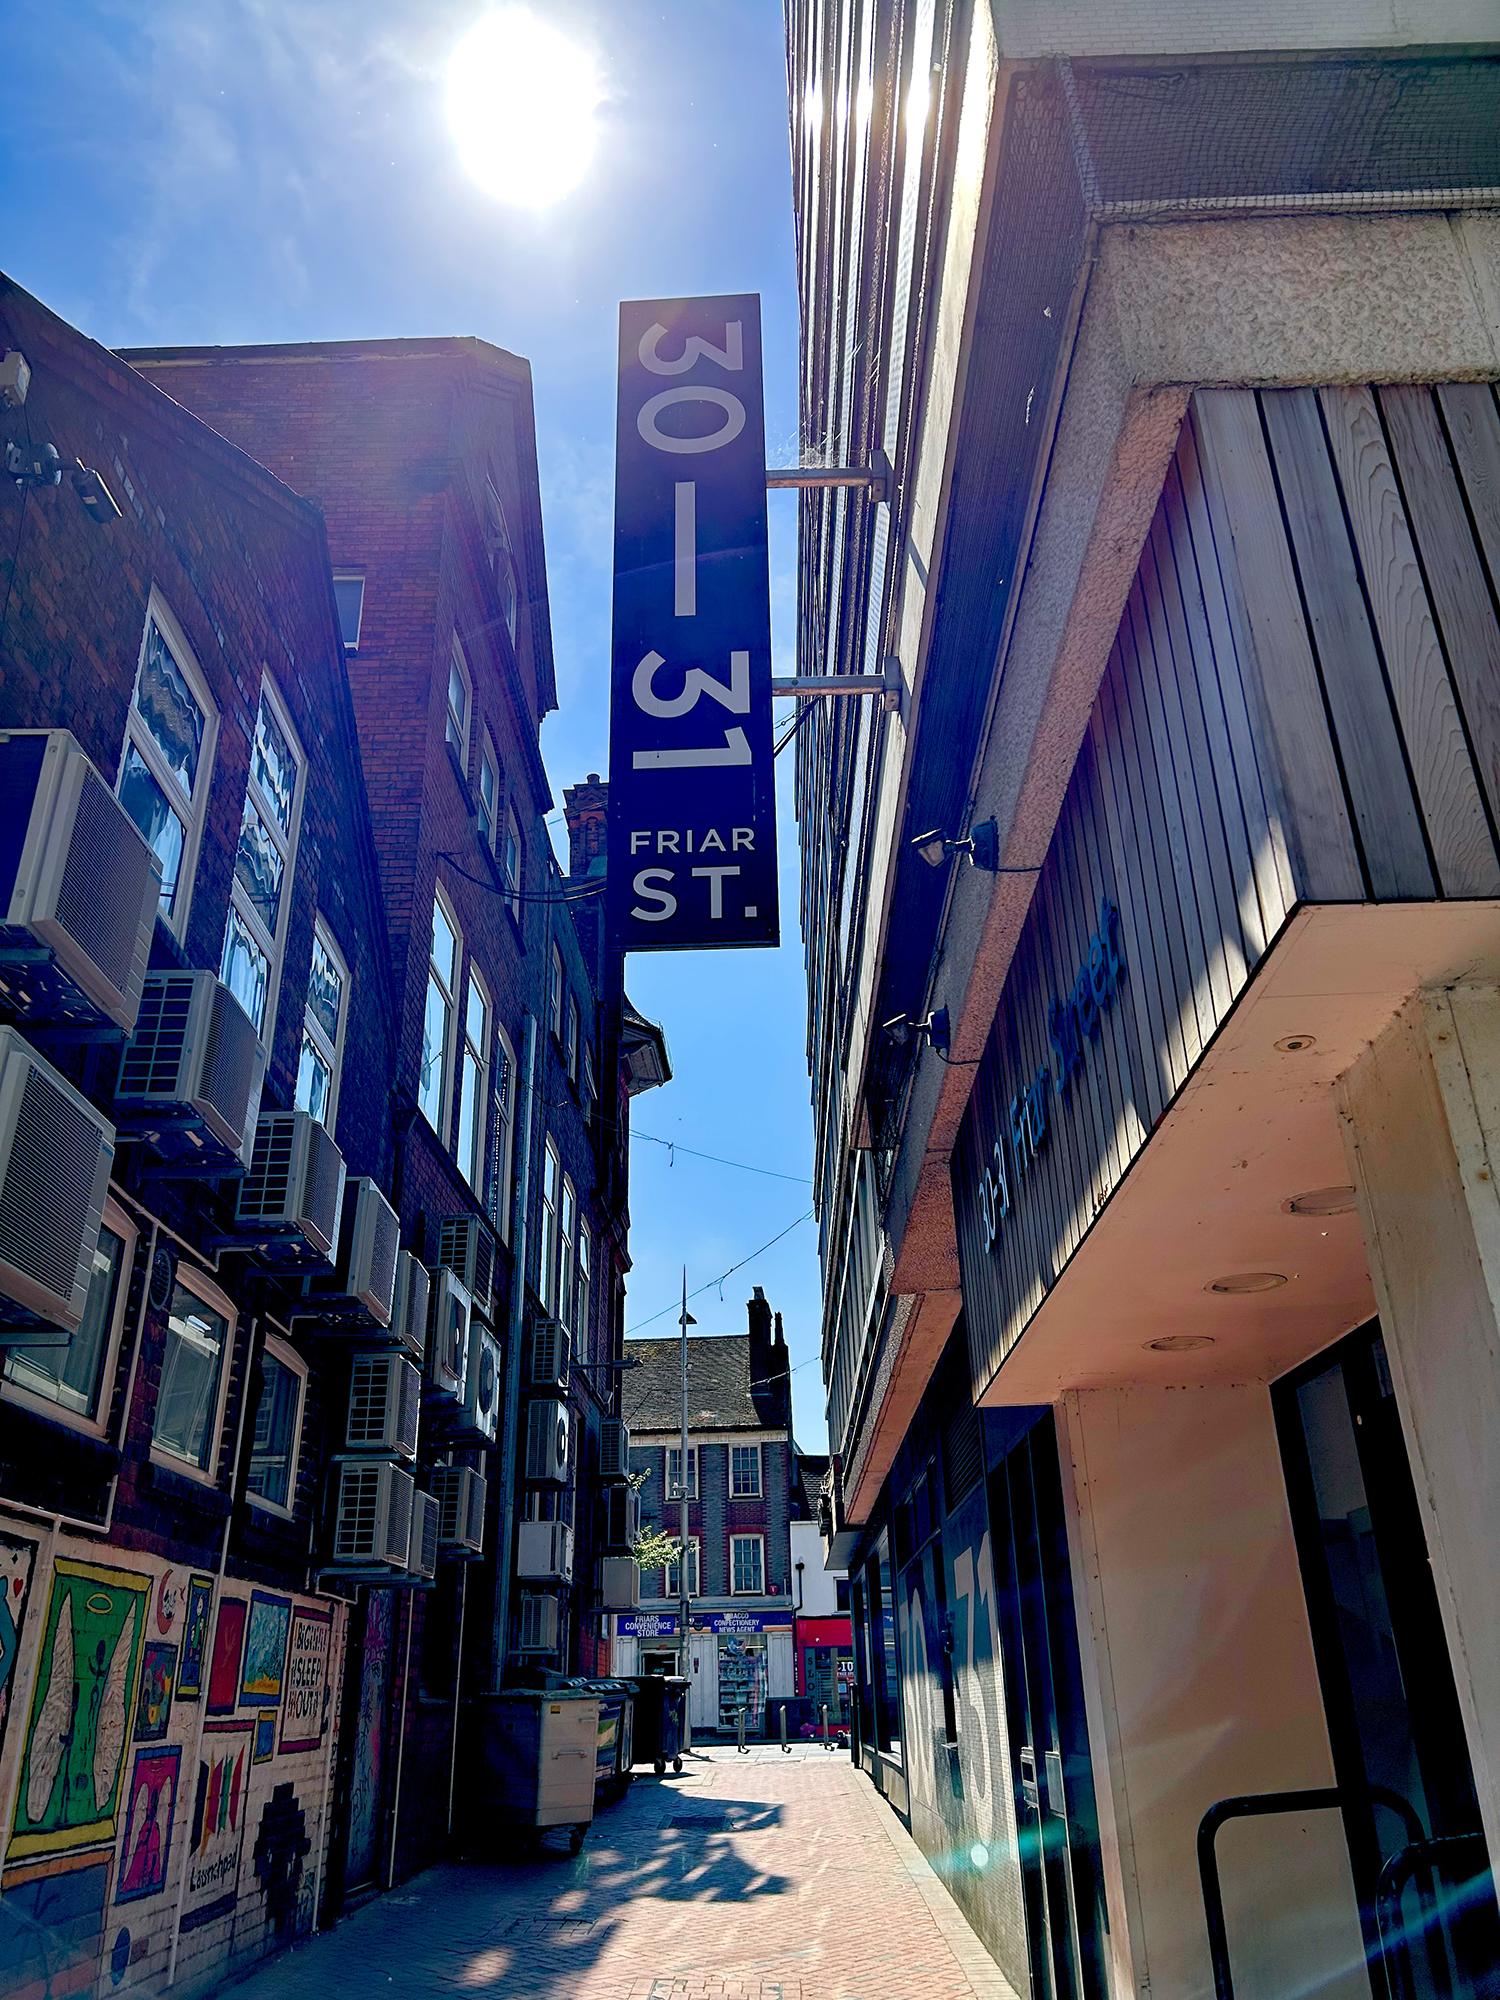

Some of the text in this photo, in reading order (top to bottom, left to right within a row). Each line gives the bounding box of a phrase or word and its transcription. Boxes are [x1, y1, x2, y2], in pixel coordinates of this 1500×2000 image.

[631, 828, 755, 854] FRIAR
[631, 866, 757, 921] ST.
[979, 895, 1119, 1254] 30-31 Friar Street
[625, 1622, 671, 1630] CONVENIENCE
[635, 1615, 660, 1623] FRIARS
[714, 1619, 760, 1627] CONFECTIONERY
[190, 1843, 238, 1891] Launchpad
